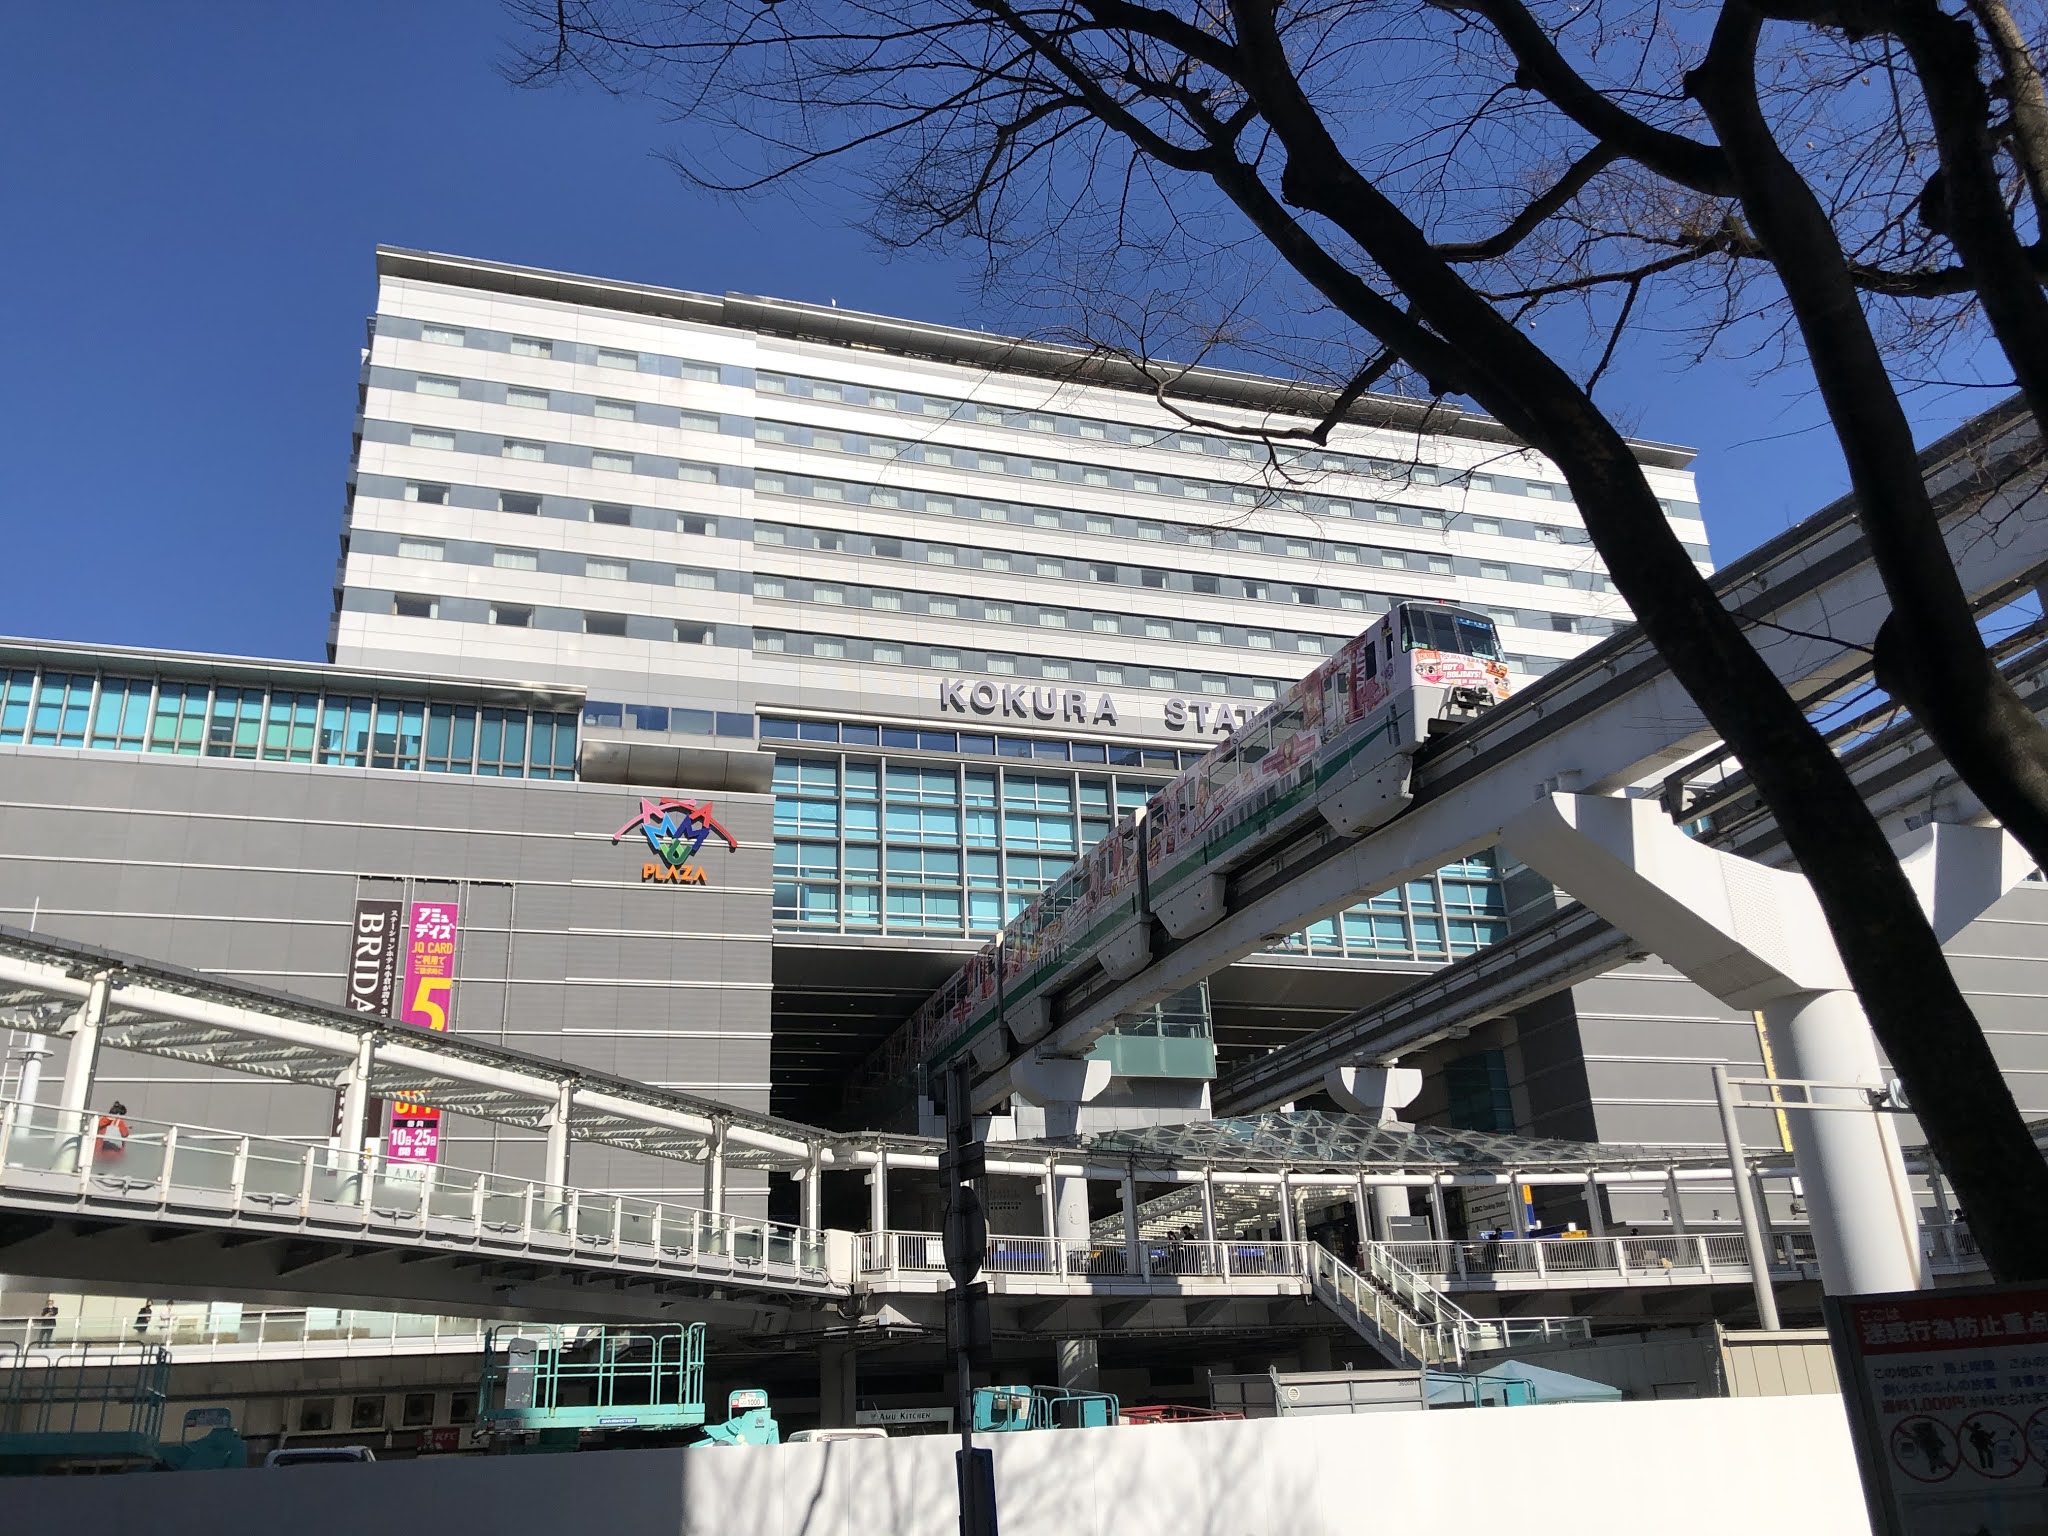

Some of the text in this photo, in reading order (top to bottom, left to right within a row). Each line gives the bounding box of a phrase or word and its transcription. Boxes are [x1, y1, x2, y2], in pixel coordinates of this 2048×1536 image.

[941, 677, 1119, 723] KOKURA
[642, 863, 708, 882] PLAZA
[418, 907, 449, 923] アミュ
[415, 922, 456, 940] デイズ
[411, 941, 453, 955] JQ CARD
[1859, 1307, 1900, 1322] ここは
[900, 1411, 931, 1420] KITCHEN
[434, 1431, 458, 1441] KFC
